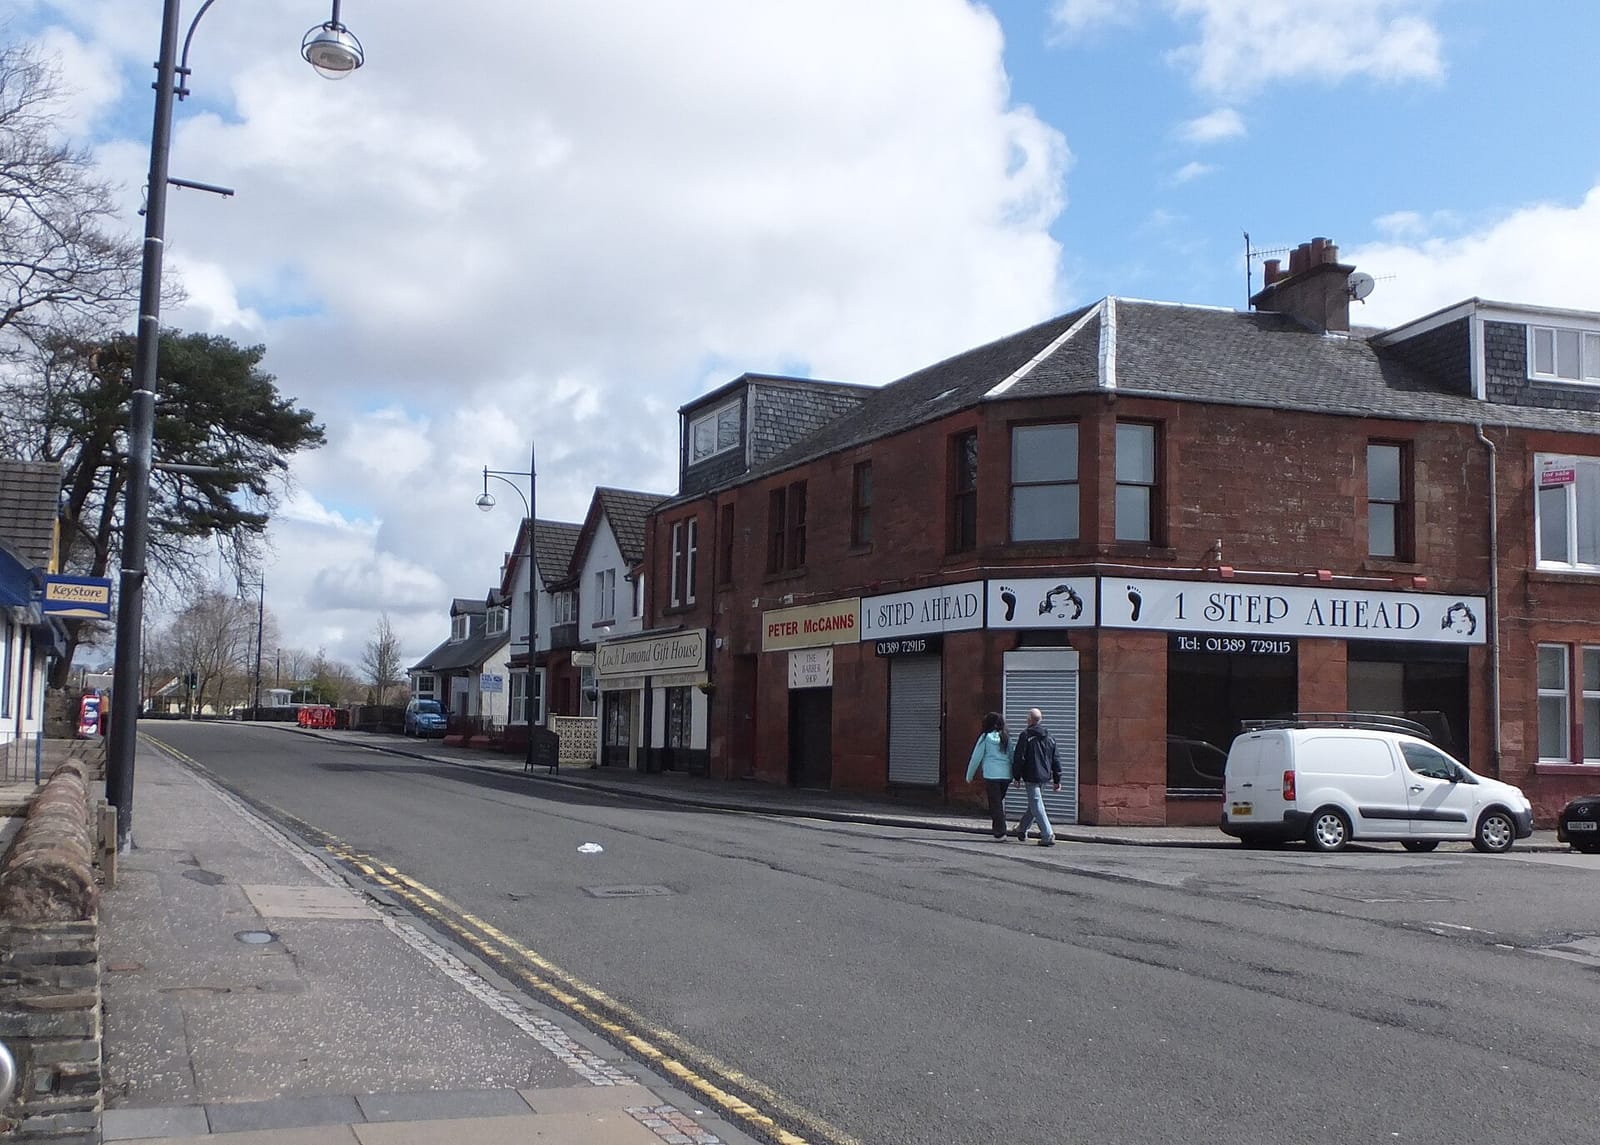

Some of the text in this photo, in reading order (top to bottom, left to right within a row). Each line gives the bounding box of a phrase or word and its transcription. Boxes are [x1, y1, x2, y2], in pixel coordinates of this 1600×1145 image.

[53, 585, 102, 598] KeyStore
[866, 593, 979, 629] 1 STEP AHEAD
[1175, 593, 1421, 630] 1 STEP AHEAD
[768, 614, 855, 638] PETER McCANNS
[602, 648, 620, 668] Loch
[621, 644, 652, 665] Lomond
[653, 642, 669, 665] Gift
[671, 641, 698, 660] House
[877, 639, 926, 655] 01389 729115
[1177, 636, 1291, 654] Tel: 01389 729115
